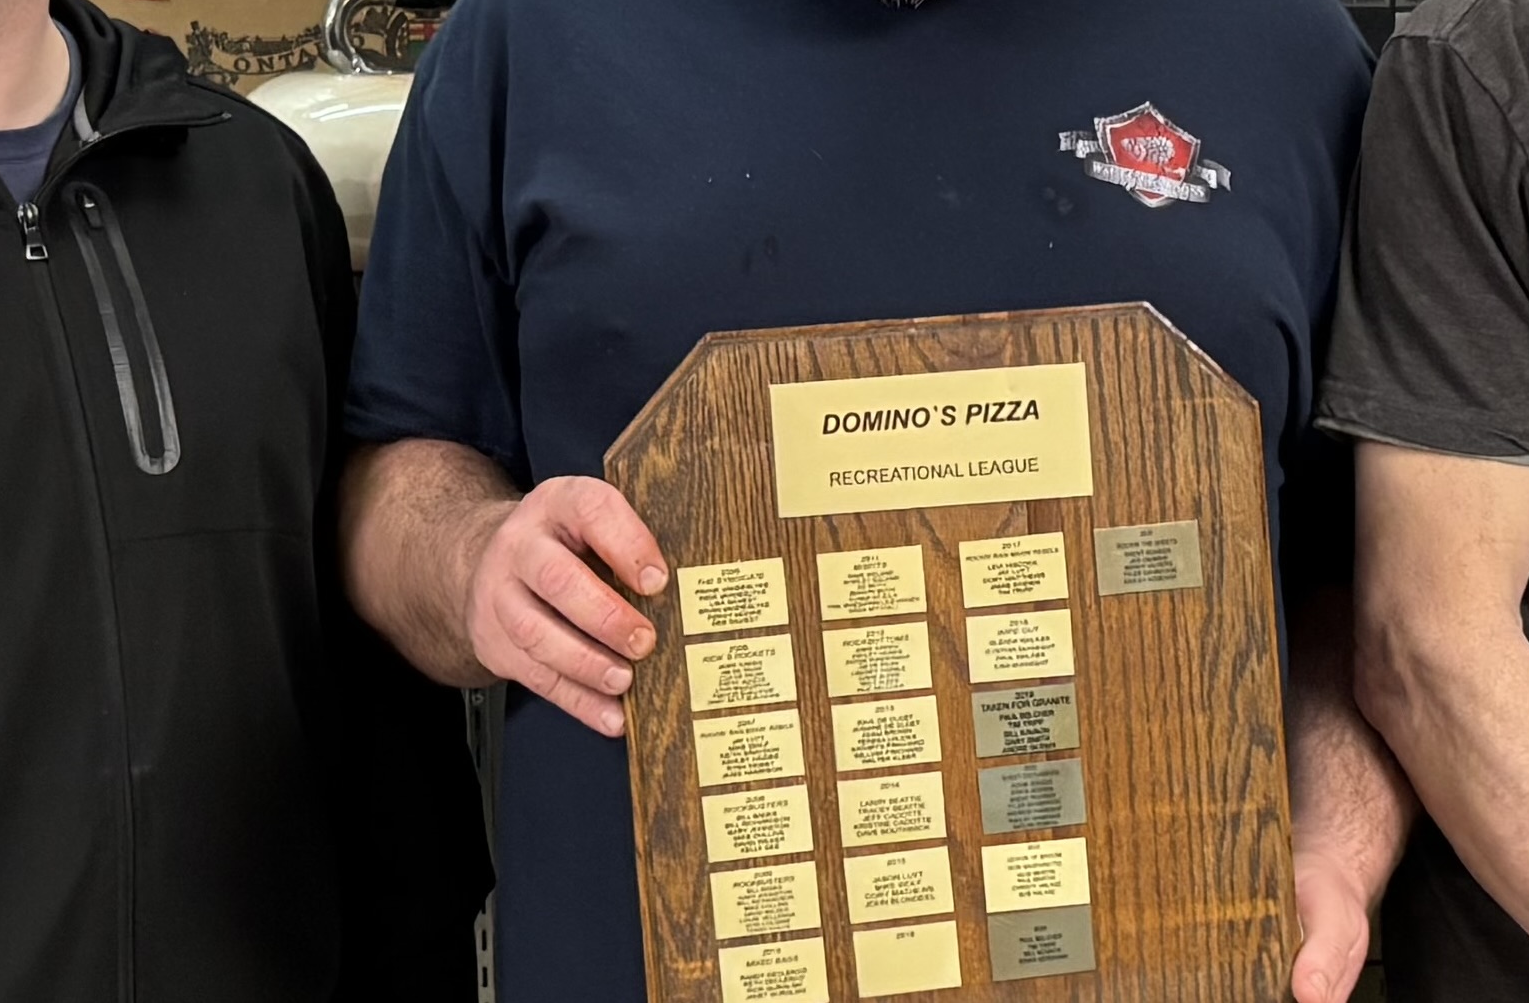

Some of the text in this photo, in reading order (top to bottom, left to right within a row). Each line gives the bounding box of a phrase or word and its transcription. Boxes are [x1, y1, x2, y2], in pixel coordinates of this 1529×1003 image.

[965, 399, 1040, 425] PIZZA
[829, 457, 1040, 488] RECREATIONAL LEAGUE
[1032, 696, 1071, 707] GRANITE
